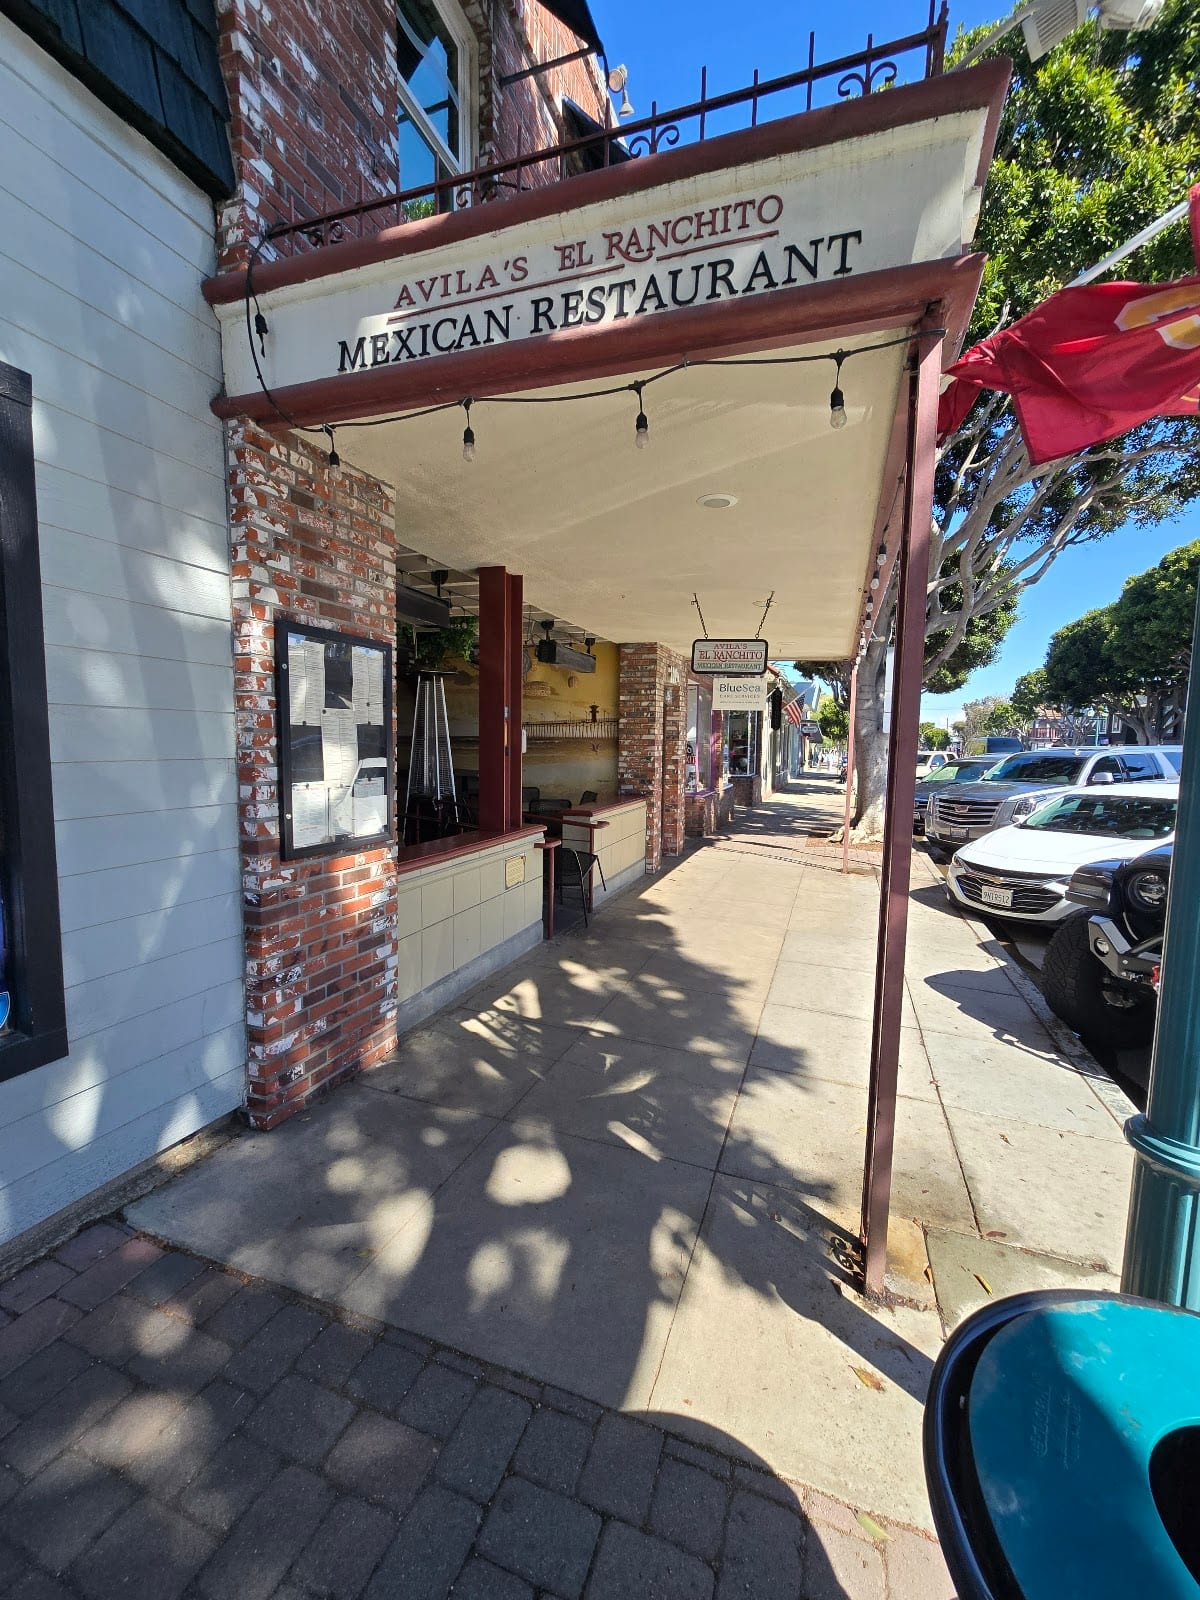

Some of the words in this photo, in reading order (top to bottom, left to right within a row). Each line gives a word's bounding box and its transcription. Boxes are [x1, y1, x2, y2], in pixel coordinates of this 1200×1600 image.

[393, 257, 530, 310] AVILA'S
[554, 246, 593, 272] EL
[602, 194, 783, 264] RANCHITO
[337, 304, 511, 374] MEXICAN
[529, 230, 863, 336] RESTAURANT
[699, 650, 711, 660] EL
[713, 650, 763, 662] RANCHITO
[719, 683, 761, 693] BlueSea
